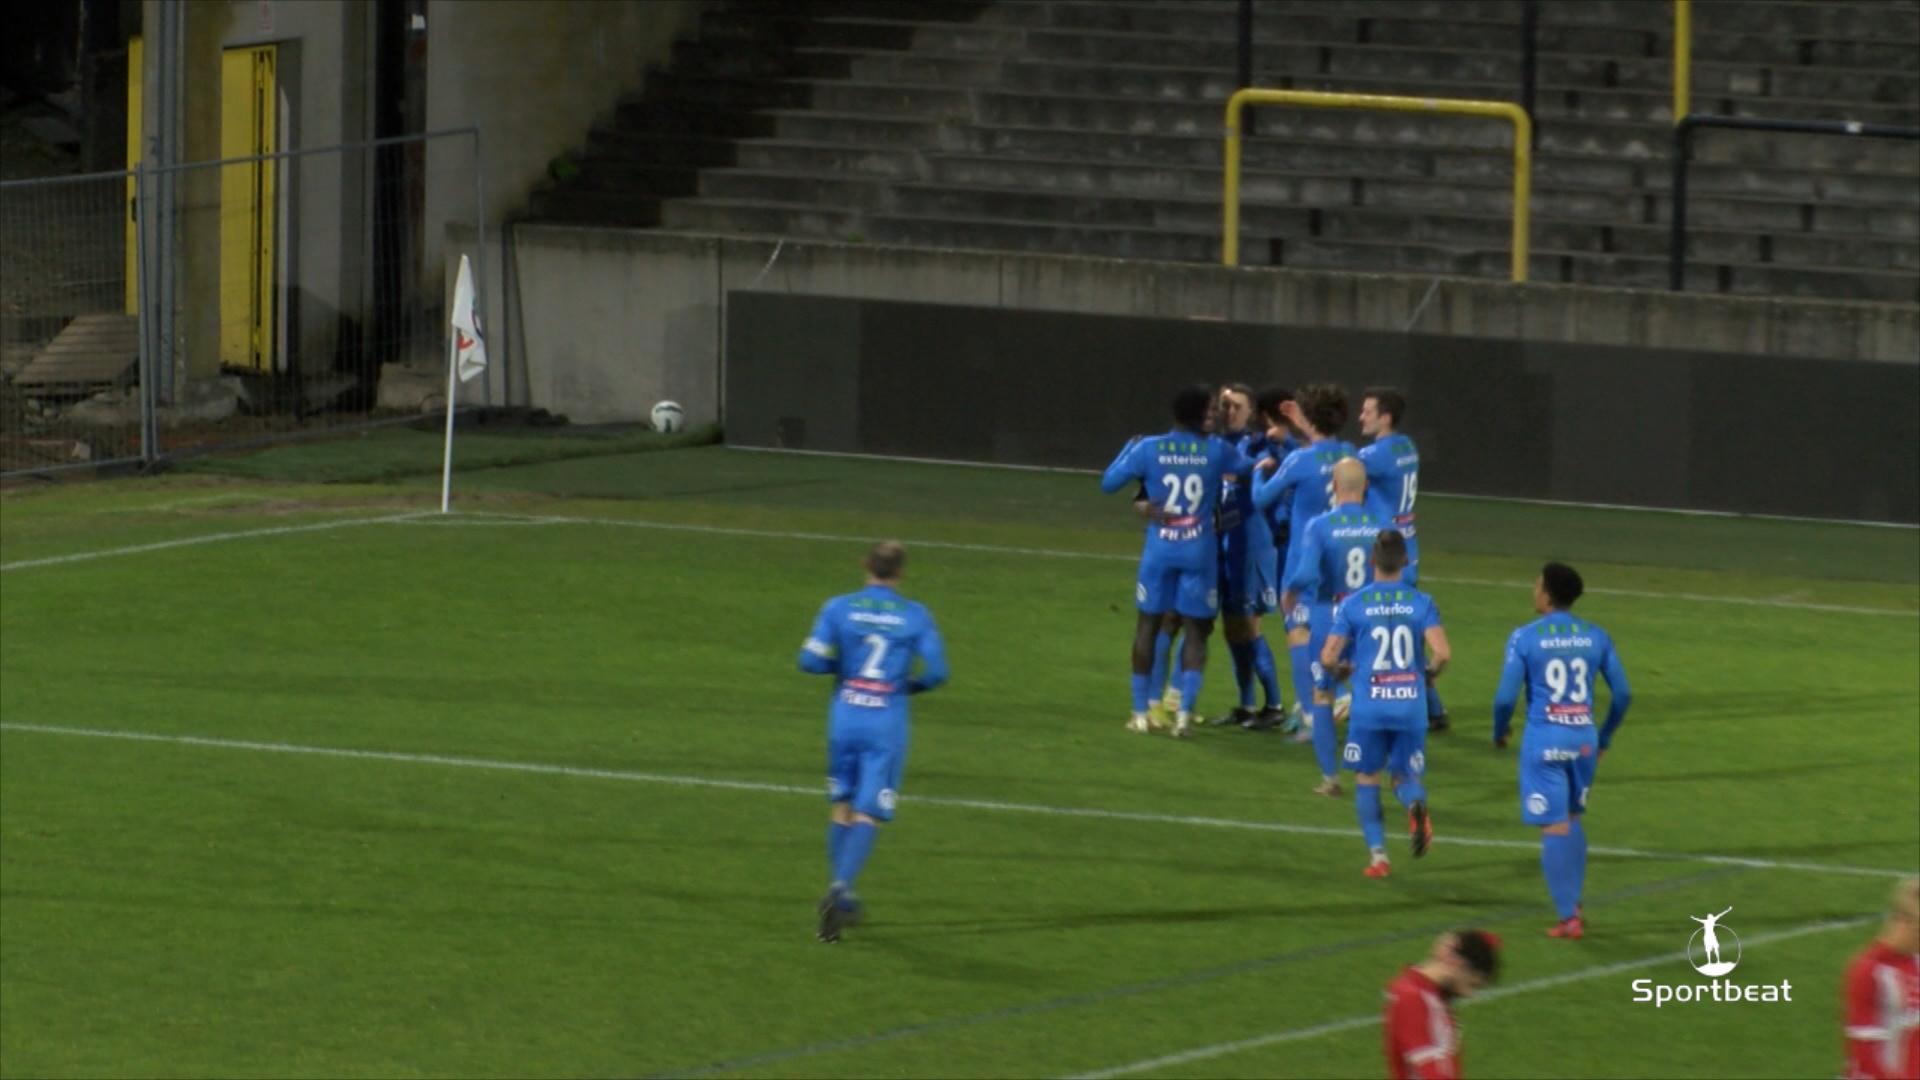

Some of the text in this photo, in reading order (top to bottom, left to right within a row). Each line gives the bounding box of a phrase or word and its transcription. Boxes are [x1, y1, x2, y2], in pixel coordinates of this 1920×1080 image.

[1162, 473, 1204, 515] 29
[1399, 471, 1418, 513] 19
[1346, 547, 1366, 589] 8
[1365, 603, 1414, 616] exterioo
[861, 633, 888, 679] 2
[1371, 625, 1415, 671] 20
[1540, 636, 1593, 649] exterioo
[1370, 685, 1418, 699] FILOU
[1545, 657, 1589, 703] 93
